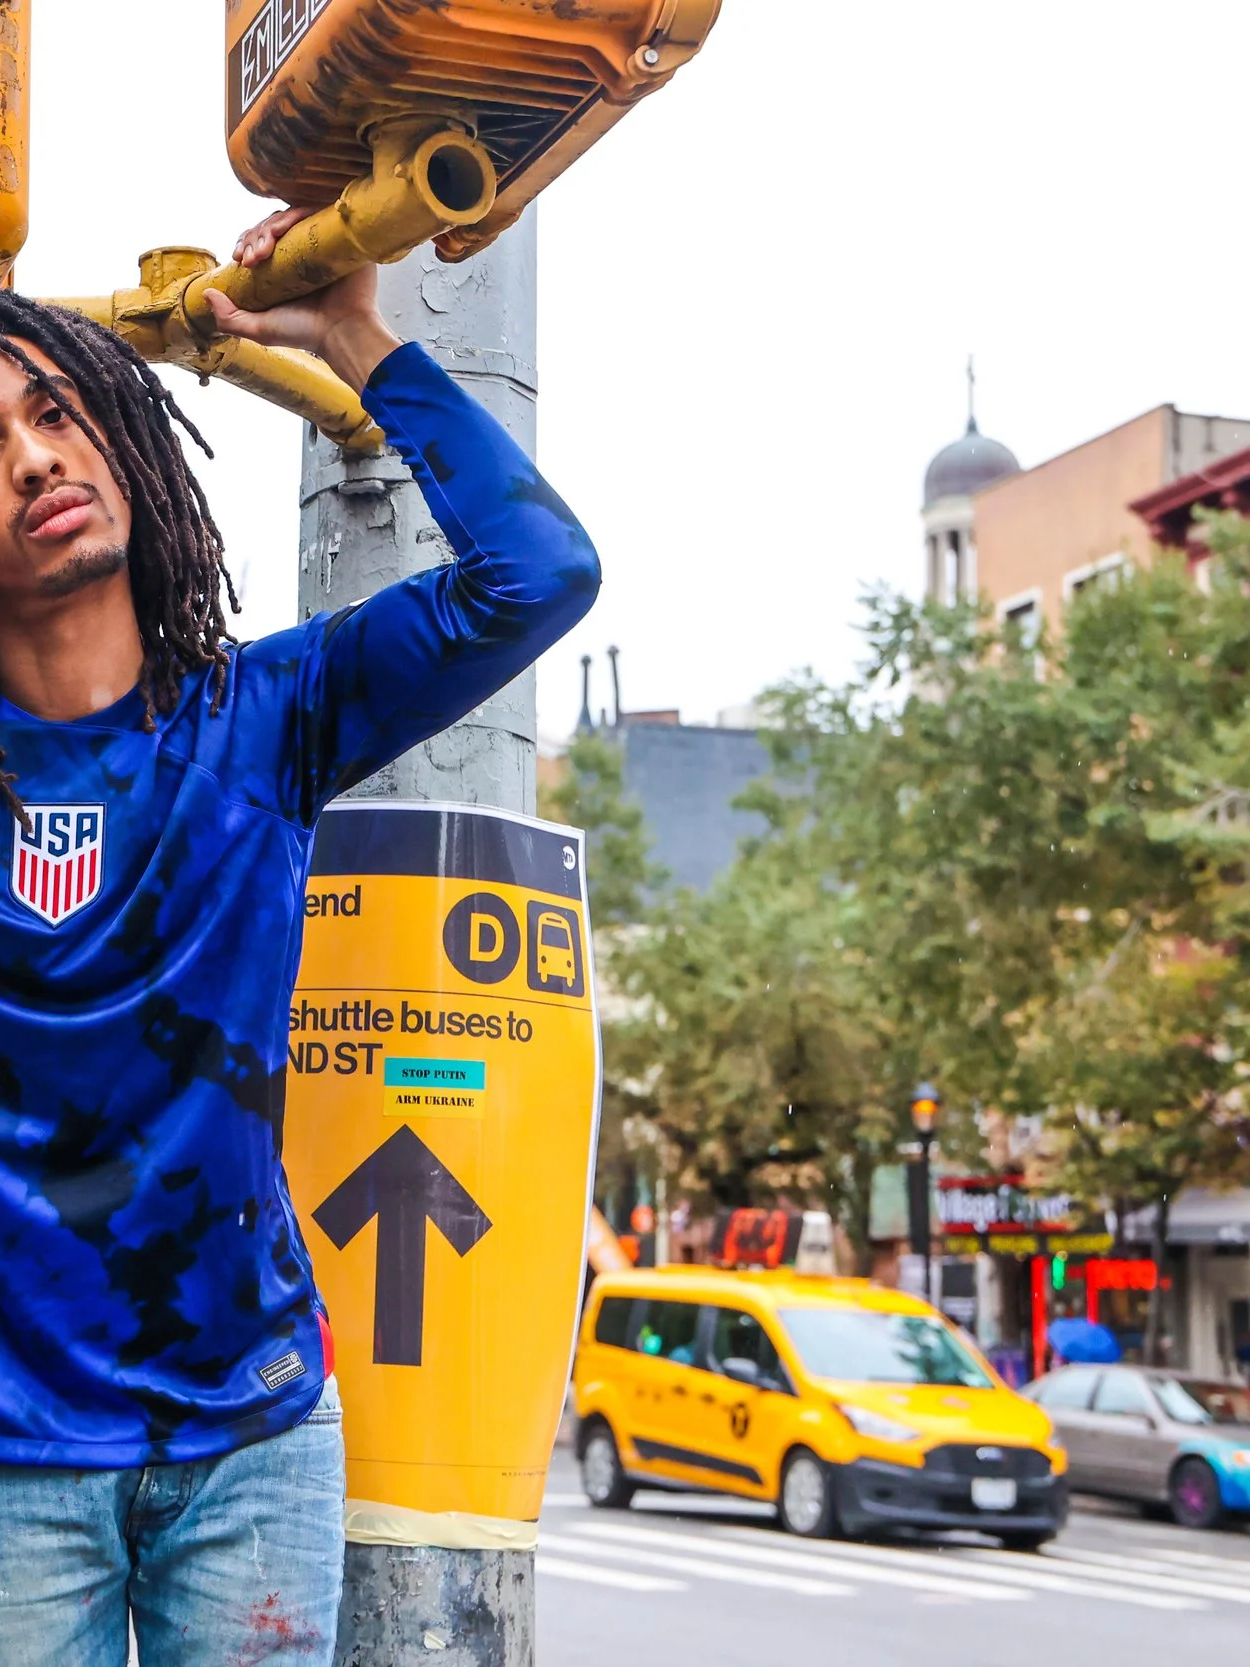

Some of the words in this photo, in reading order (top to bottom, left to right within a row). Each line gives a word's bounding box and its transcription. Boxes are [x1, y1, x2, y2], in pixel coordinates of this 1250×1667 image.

[20, 811, 99, 858] USA
[303, 884, 362, 918] end
[469, 912, 505, 964] D
[289, 999, 395, 1033] shuttle
[400, 1000, 503, 1040] buses
[506, 1010, 534, 1043] to
[333, 1041, 384, 1075] ST
[401, 1068, 431, 1079] STOP
[434, 1069, 467, 1081] PUTIN
[395, 1094, 421, 1105] ARM
[424, 1095, 475, 1108] UKRAINE
